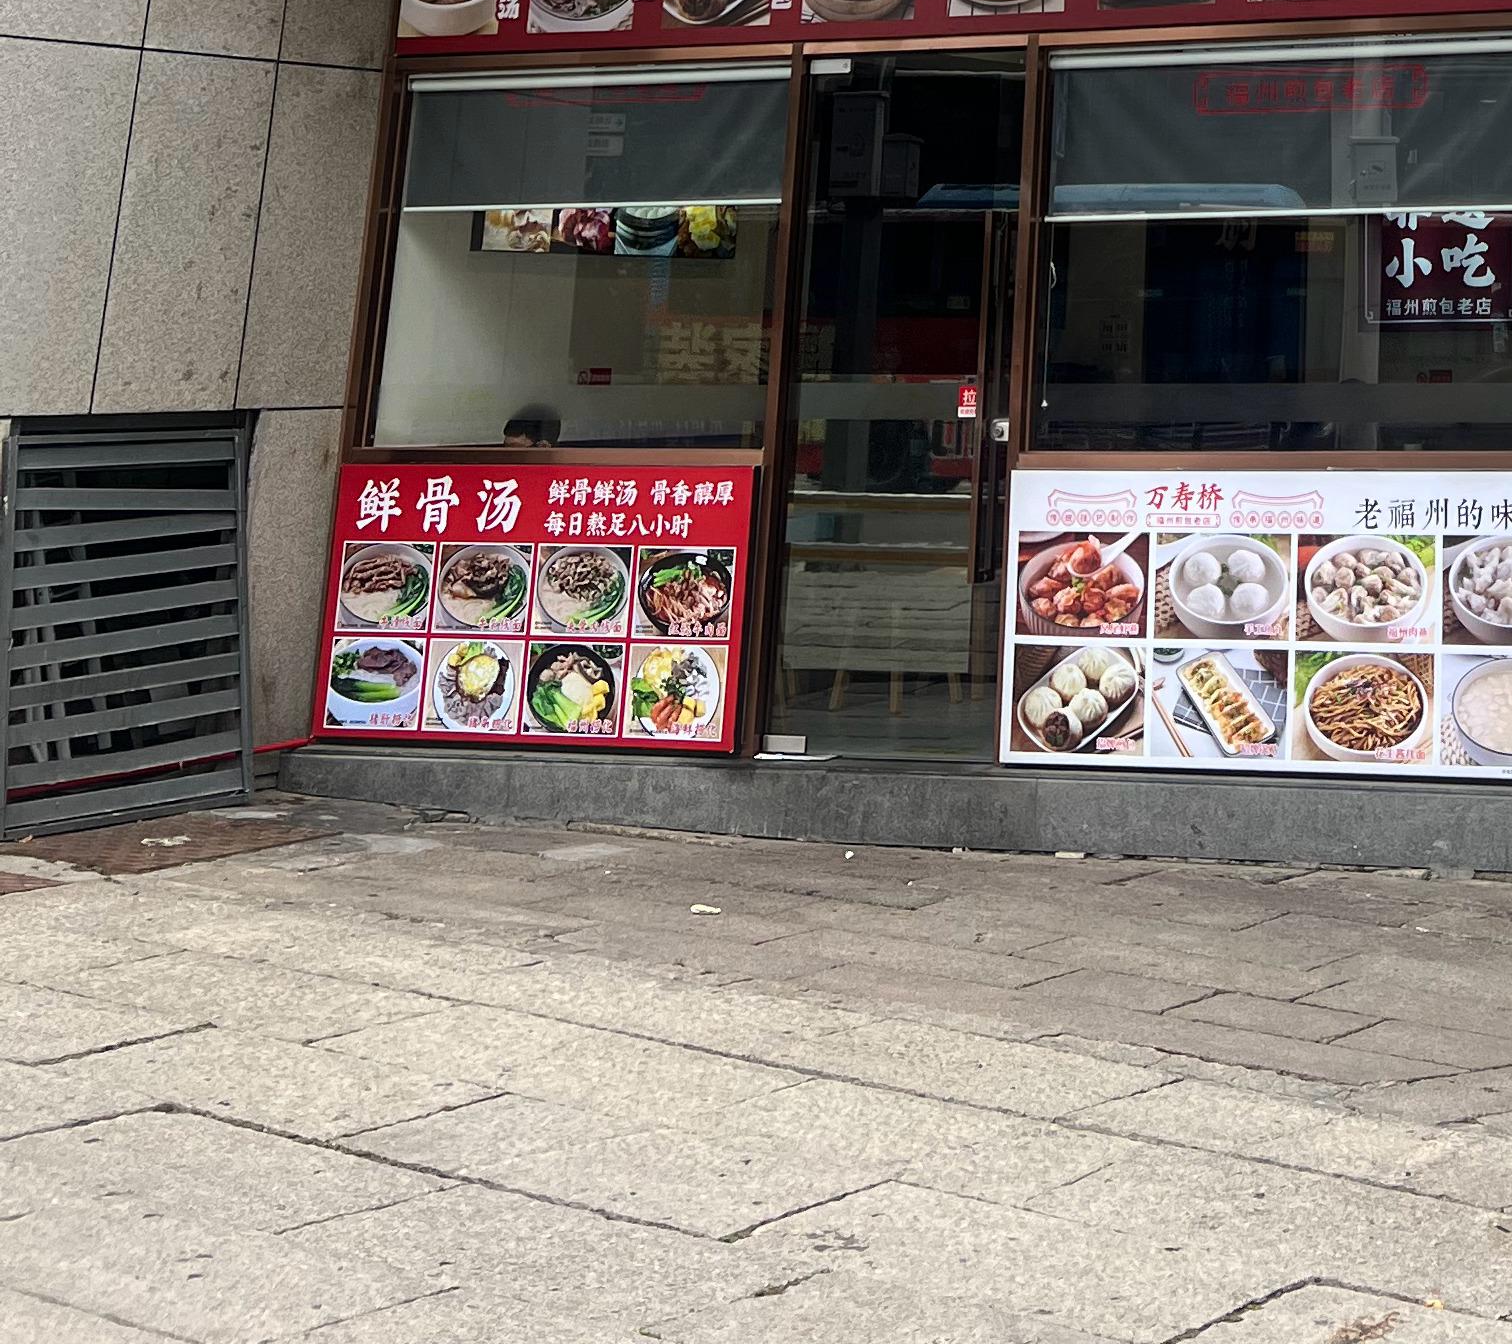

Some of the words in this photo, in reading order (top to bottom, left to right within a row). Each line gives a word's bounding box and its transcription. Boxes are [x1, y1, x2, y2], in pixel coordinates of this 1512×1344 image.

[1384, 233, 1496, 288] 小吃
[1386, 298, 1492, 316] 福州煎包老店
[962, 389, 977, 406] 拉
[355, 475, 523, 535] 鲜骨汤
[547, 479, 639, 506] 鲜骨鲜汤
[650, 479, 735, 506] 骨香醇厚
[1144, 481, 1225, 512] 万寿桥
[544, 511, 694, 539] 每日熬足八小时
